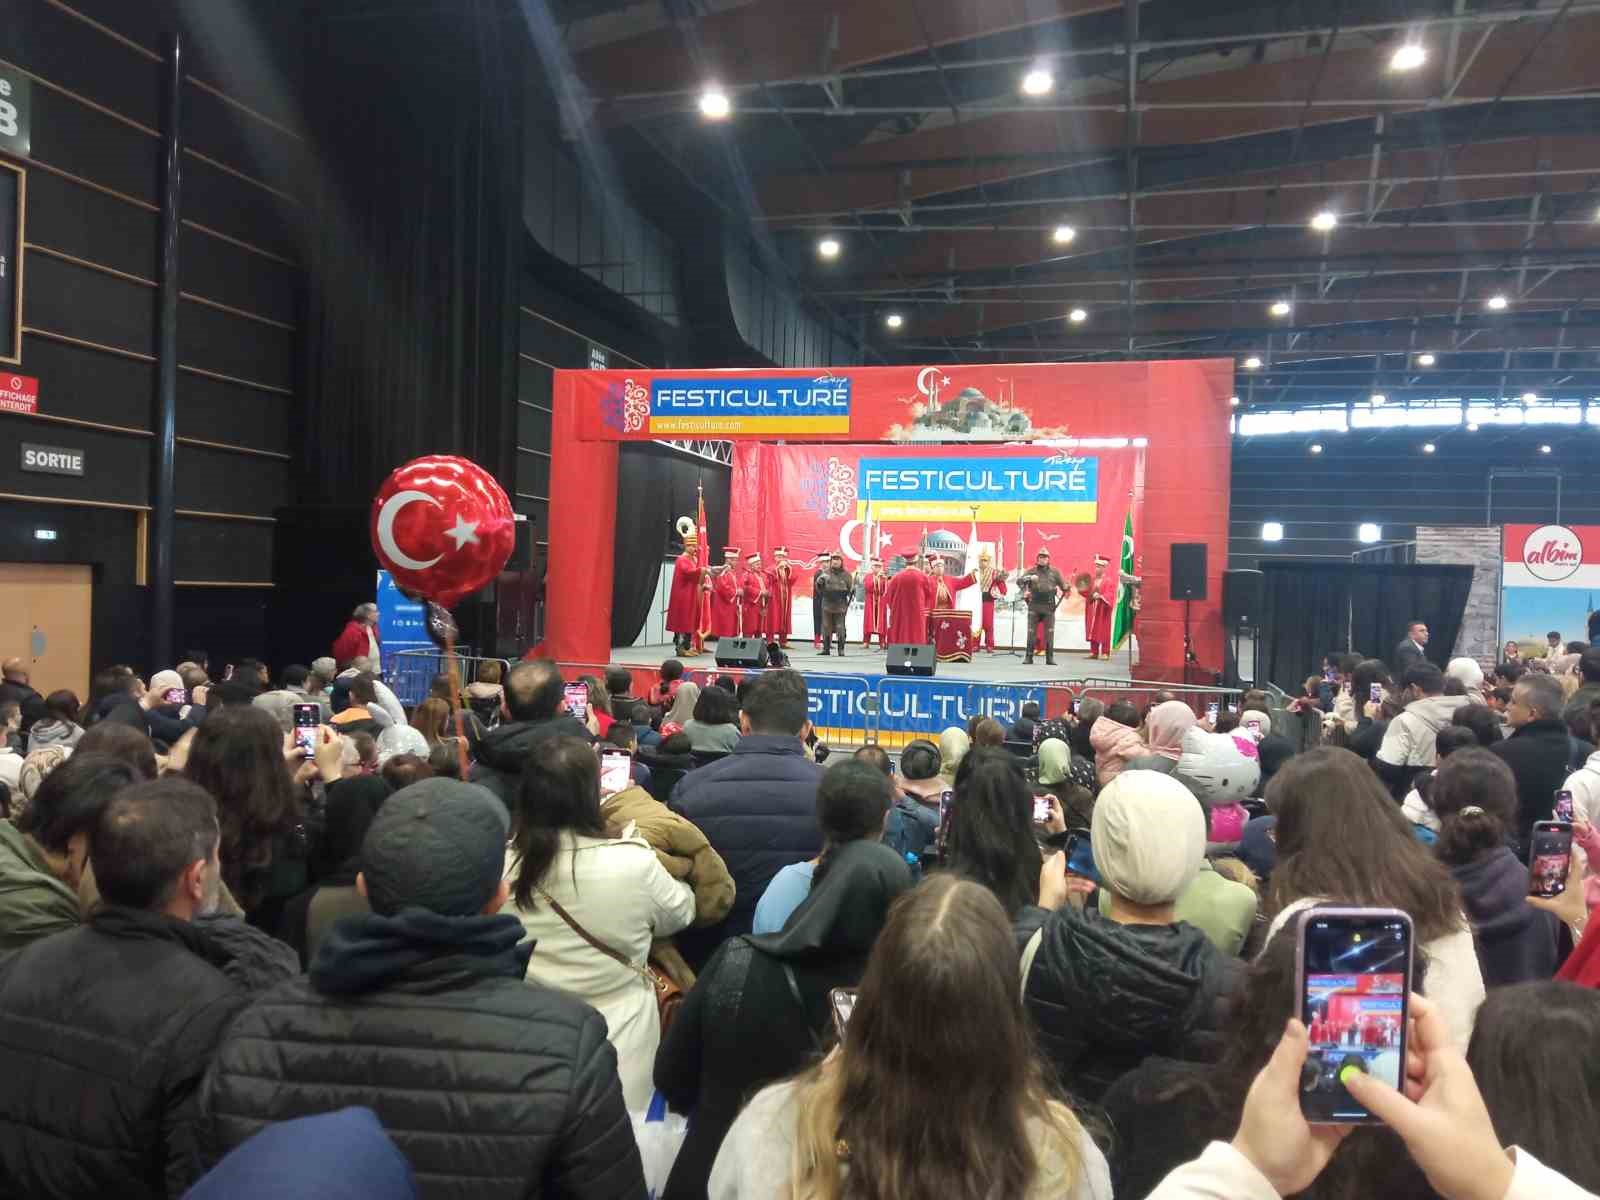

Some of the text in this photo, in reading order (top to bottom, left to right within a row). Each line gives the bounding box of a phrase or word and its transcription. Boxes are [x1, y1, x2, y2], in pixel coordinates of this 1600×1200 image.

[0, 389, 36, 404] FFICHAGE
[0, 400, 32, 412] NTERDIT
[657, 388, 848, 408] FESTICULTURE
[25, 450, 81, 470] SORTIE
[865, 469, 1087, 491] FESTICULTURE
[807, 688, 1040, 723] STICULTUR
